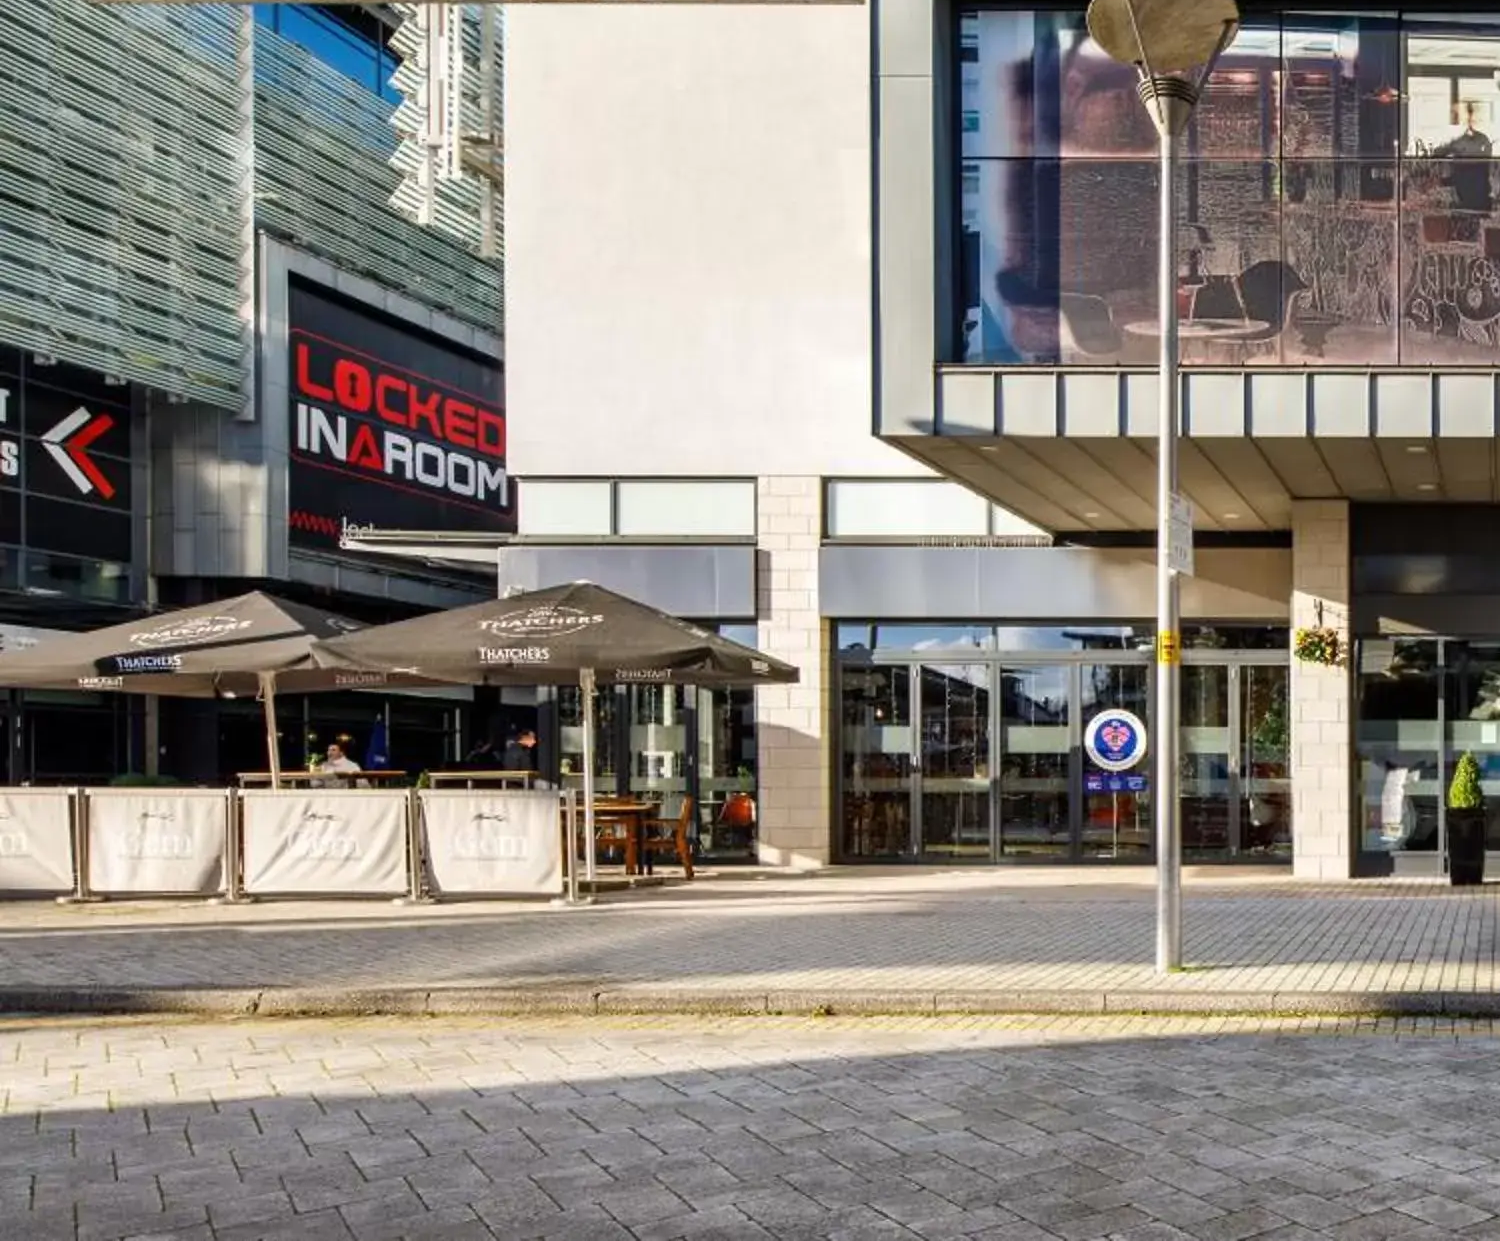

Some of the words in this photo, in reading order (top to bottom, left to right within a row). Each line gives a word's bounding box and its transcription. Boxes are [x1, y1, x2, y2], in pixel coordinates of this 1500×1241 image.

[297, 342, 507, 457] LOCKED
[479, 613, 605, 630] THATCHERS
[479, 646, 550, 660] THATCHERS
